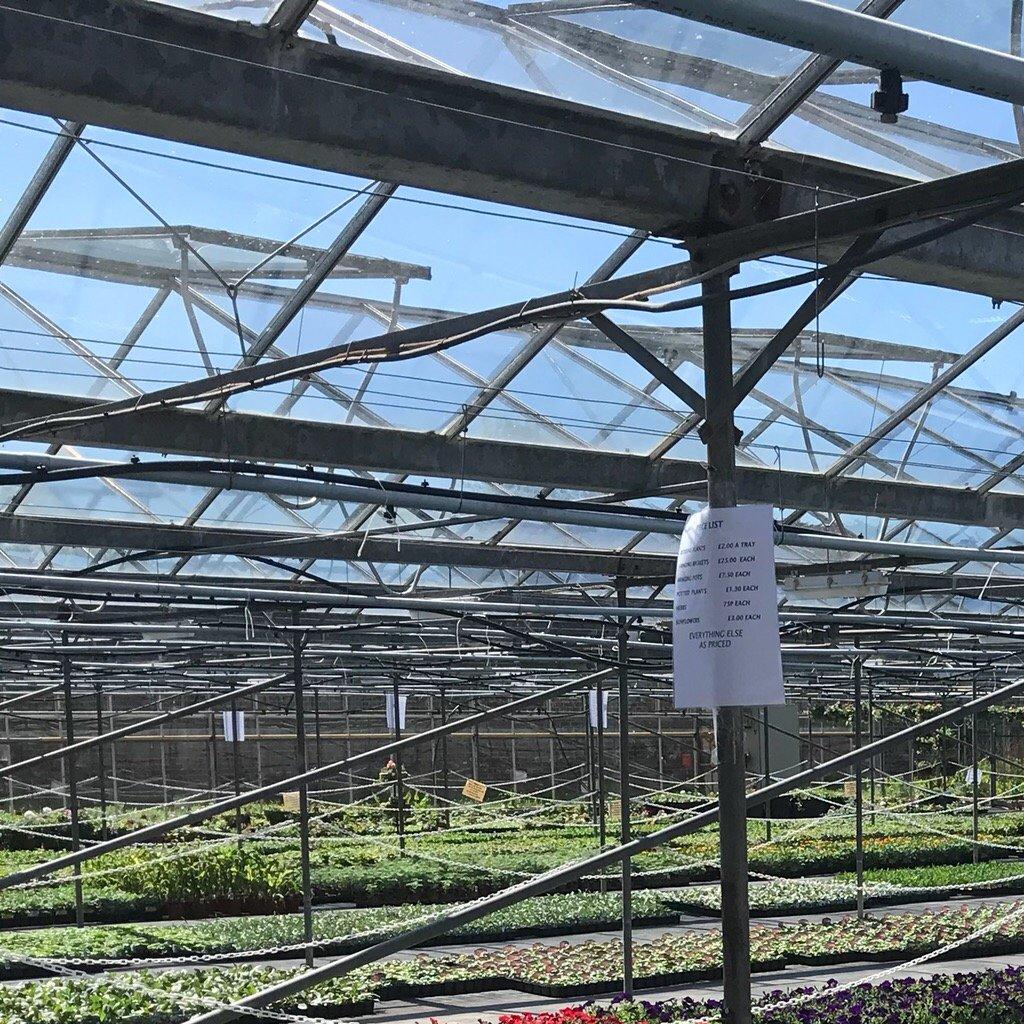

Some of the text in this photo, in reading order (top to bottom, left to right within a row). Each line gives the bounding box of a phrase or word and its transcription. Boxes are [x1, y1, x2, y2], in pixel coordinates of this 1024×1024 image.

[708, 520, 724, 530] LIST
[717, 542, 734, 550] £2.00
[718, 571, 734, 579] £7.50
[691, 588, 707, 596] PLANTS
[689, 629, 744, 640] EVERYTHING ELSE
[699, 639, 732, 649] AS PRICED
